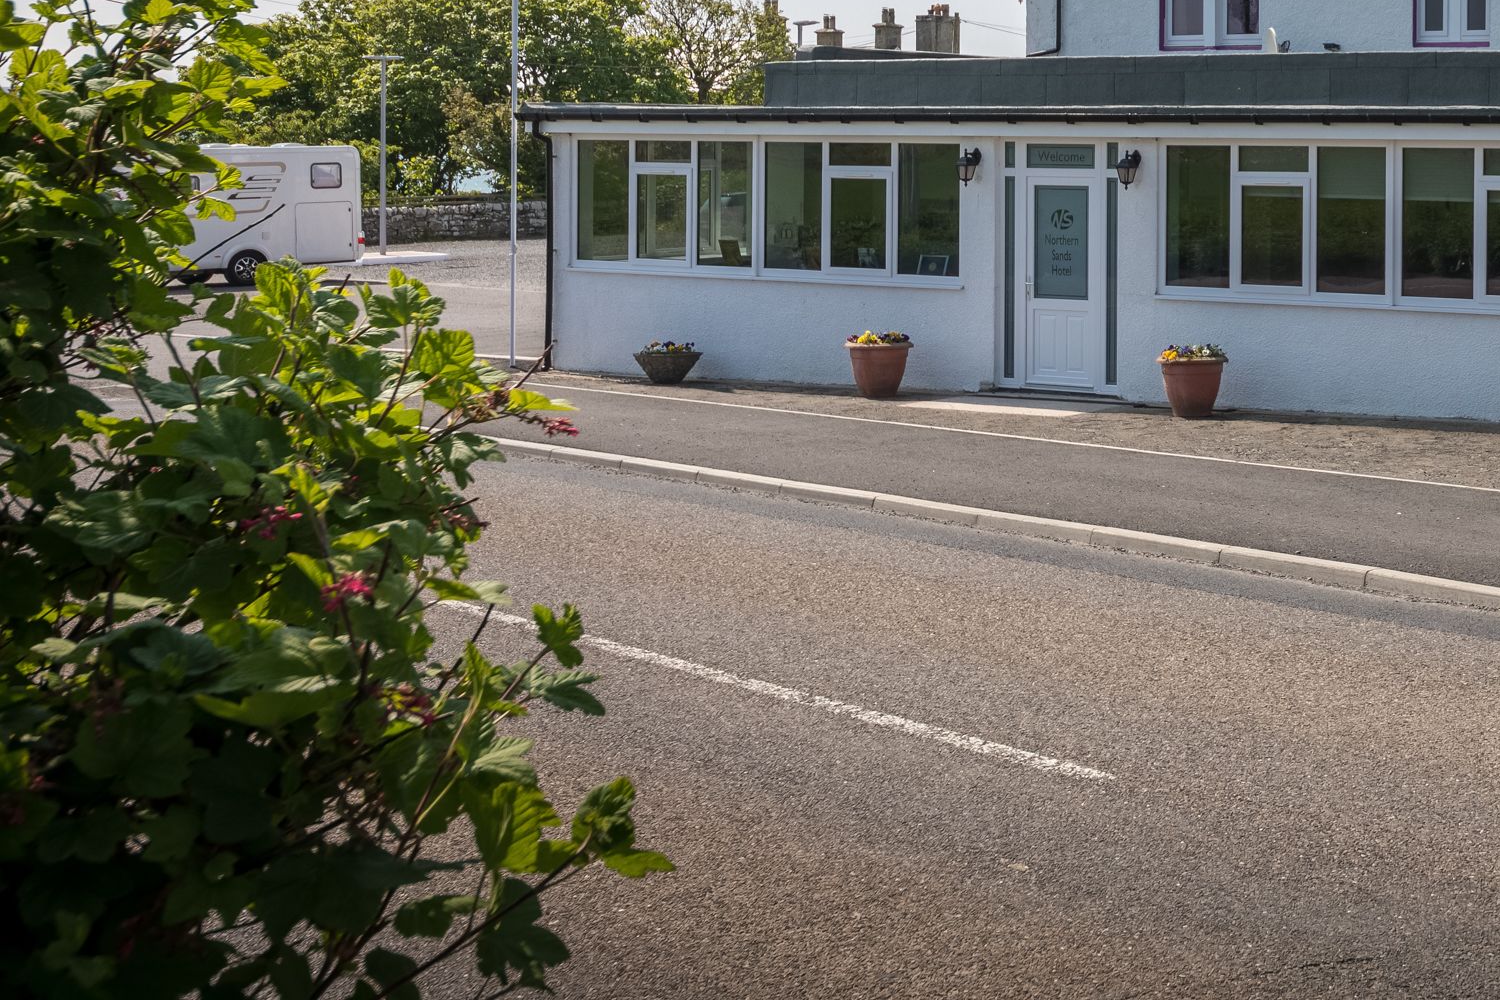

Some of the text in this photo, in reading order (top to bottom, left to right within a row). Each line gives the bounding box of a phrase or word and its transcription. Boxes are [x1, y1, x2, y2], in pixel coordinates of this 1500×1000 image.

[1038, 150, 1085, 163] Welcome
[1051, 209, 1074, 230] NS
[1044, 234, 1079, 246] Northern
[1051, 249, 1072, 261] Sands
[1051, 265, 1072, 276] Hotel
